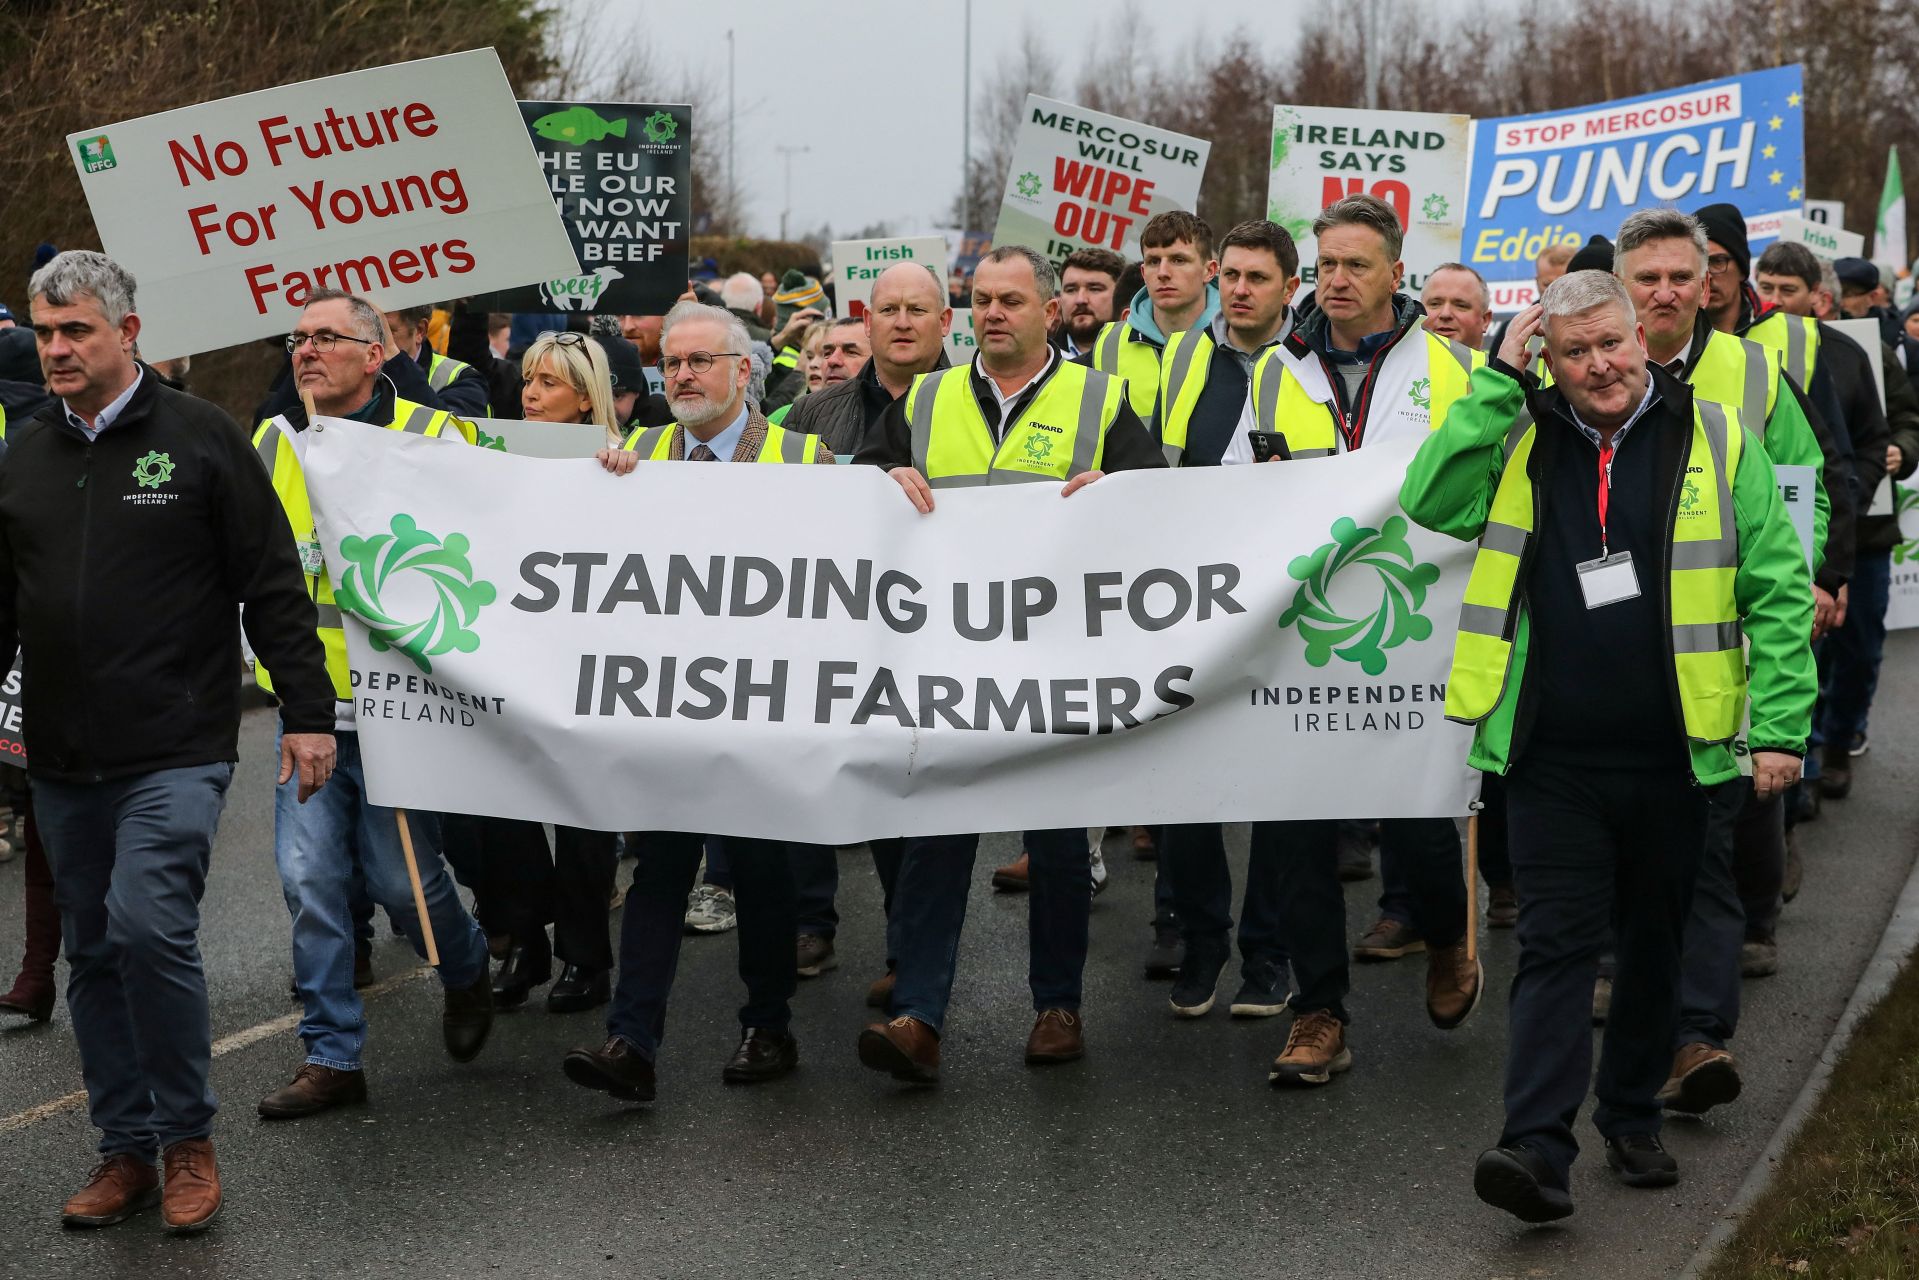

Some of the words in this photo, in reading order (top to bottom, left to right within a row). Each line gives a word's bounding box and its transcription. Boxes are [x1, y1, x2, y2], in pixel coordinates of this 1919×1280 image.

[1505, 122, 1575, 147] STOP
[1585, 94, 1732, 137] MERCOSUR
[168, 134, 249, 187] No
[258, 102, 439, 167] Future
[1032, 108, 1199, 167] MERCOSUR
[1295, 124, 1446, 151] IRELAND
[539, 152, 582, 170] HE
[597, 152, 639, 171] EU
[1078, 141, 1143, 172] WILL
[1319, 150, 1407, 173] SAYS
[1479, 121, 1756, 219] PUNCH
[600, 175, 677, 195] OUR
[1053, 156, 1156, 216] WIPE
[188, 204, 277, 255] For
[289, 168, 469, 230] Young
[579, 198, 670, 217] NOW
[575, 220, 681, 240] WANT
[1054, 202, 1134, 251] OUT
[1803, 227, 1837, 250] Irish
[584, 243, 664, 262] BEEF
[866, 245, 914, 260] Irish
[245, 239, 476, 315] Farmers
[550, 275, 603, 299] Beef
[510, 551, 928, 634] STANDING
[952, 576, 1058, 642] UP
[1083, 562, 1247, 637] FOR
[350, 669, 505, 715] DEPENDENT
[574, 654, 789, 722] IRISH
[814, 661, 1195, 735] FARMERS
[1251, 684, 1446, 705] INDEPENDEN
[354, 697, 475, 727] IRELAND
[1294, 711, 1425, 732] IRELAND
